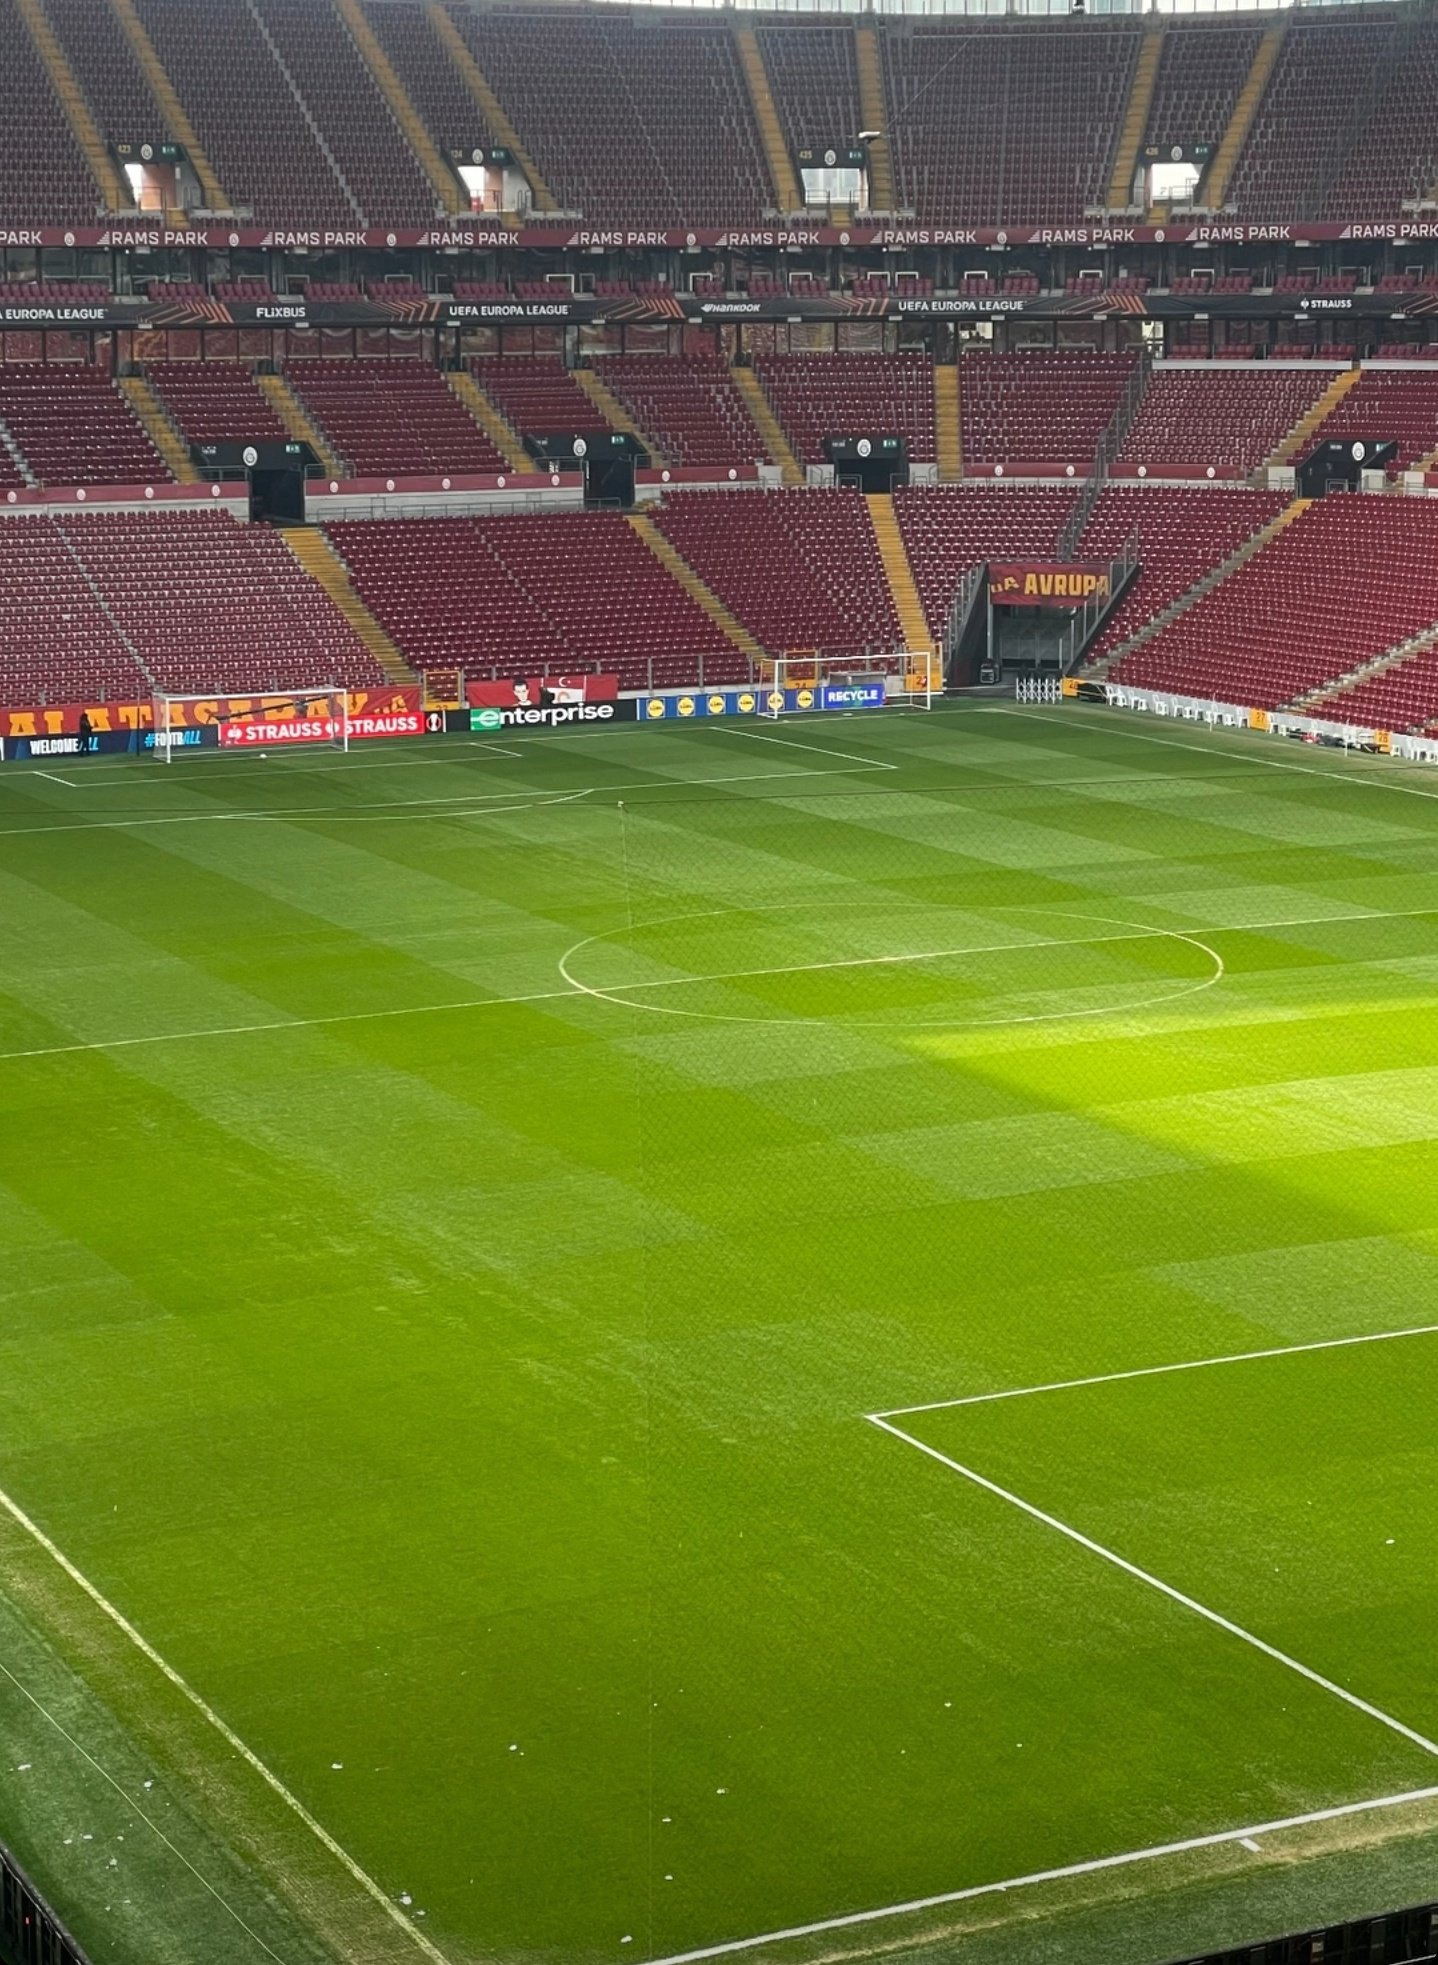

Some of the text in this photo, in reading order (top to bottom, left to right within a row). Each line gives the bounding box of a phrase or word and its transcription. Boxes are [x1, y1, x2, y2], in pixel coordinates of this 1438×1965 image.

[0, 231, 42, 245] PARK
[112, 231, 208, 245] RAMS PARK
[274, 231, 367, 245] RAMS PARK
[580, 232, 667, 244] RAMS PARK
[884, 230, 976, 244] RAMS PARK
[1042, 229, 1134, 243] RAMS PARK
[1200, 226, 1290, 240] RAMS PARK
[1352, 224, 1438, 238] RAMS PARK
[430, 232, 519, 245] RAMS PARK
[729, 232, 819, 245] RAMS PARK
[449, 305, 569, 317] UEFA EUROPA LEAGUE
[898, 300, 1024, 311] UEFA EUROPA LEAGUE
[1310, 299, 1352, 309] STRAUSS
[6, 308, 54, 319] EUROPA
[57, 308, 105, 319] LEAGUE
[1024, 573, 1110, 596] AVRUPA
[828, 689, 878, 703] RECYCLE
[478, 703, 613, 727] enterprise
[246, 723, 322, 741] STRAUSS
[344, 716, 417, 734] STRAUSS
[30, 738, 79, 755] WELCOME
